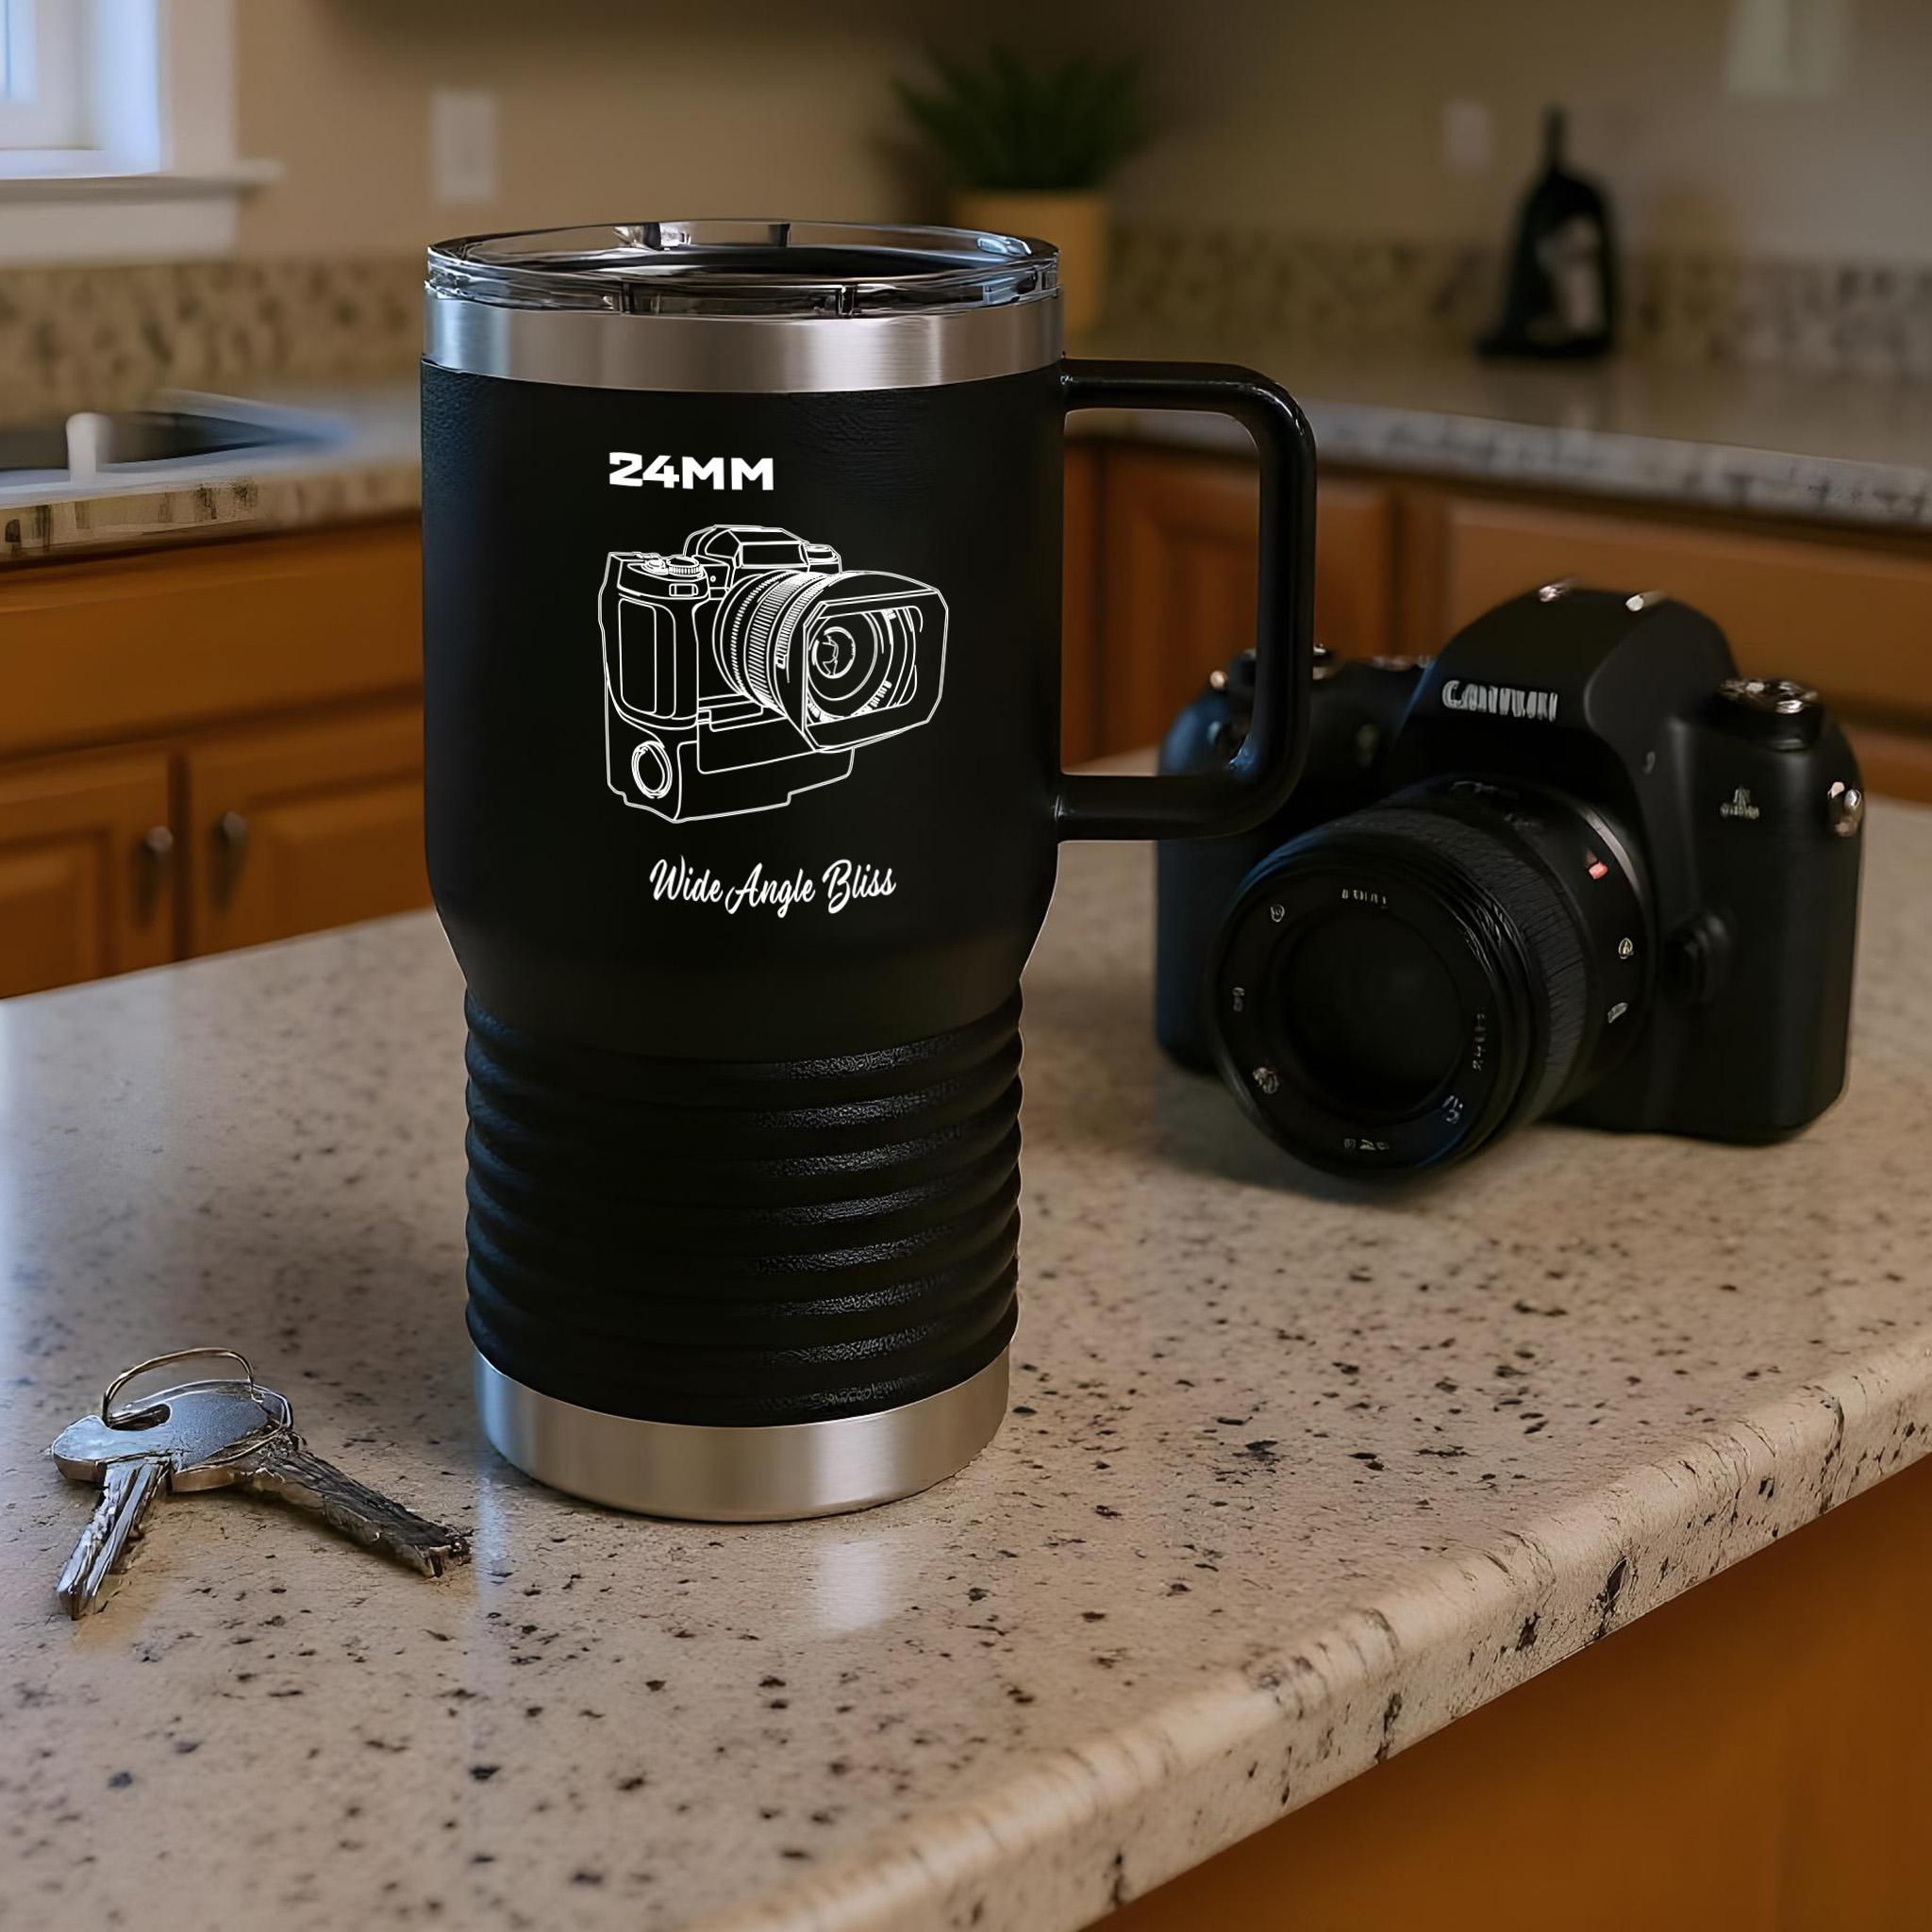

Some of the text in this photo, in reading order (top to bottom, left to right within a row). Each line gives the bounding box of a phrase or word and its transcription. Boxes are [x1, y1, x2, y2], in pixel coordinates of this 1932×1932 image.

[608, 451, 774, 491] 24MM
[649, 856, 897, 919] Wide Angle Bliss
